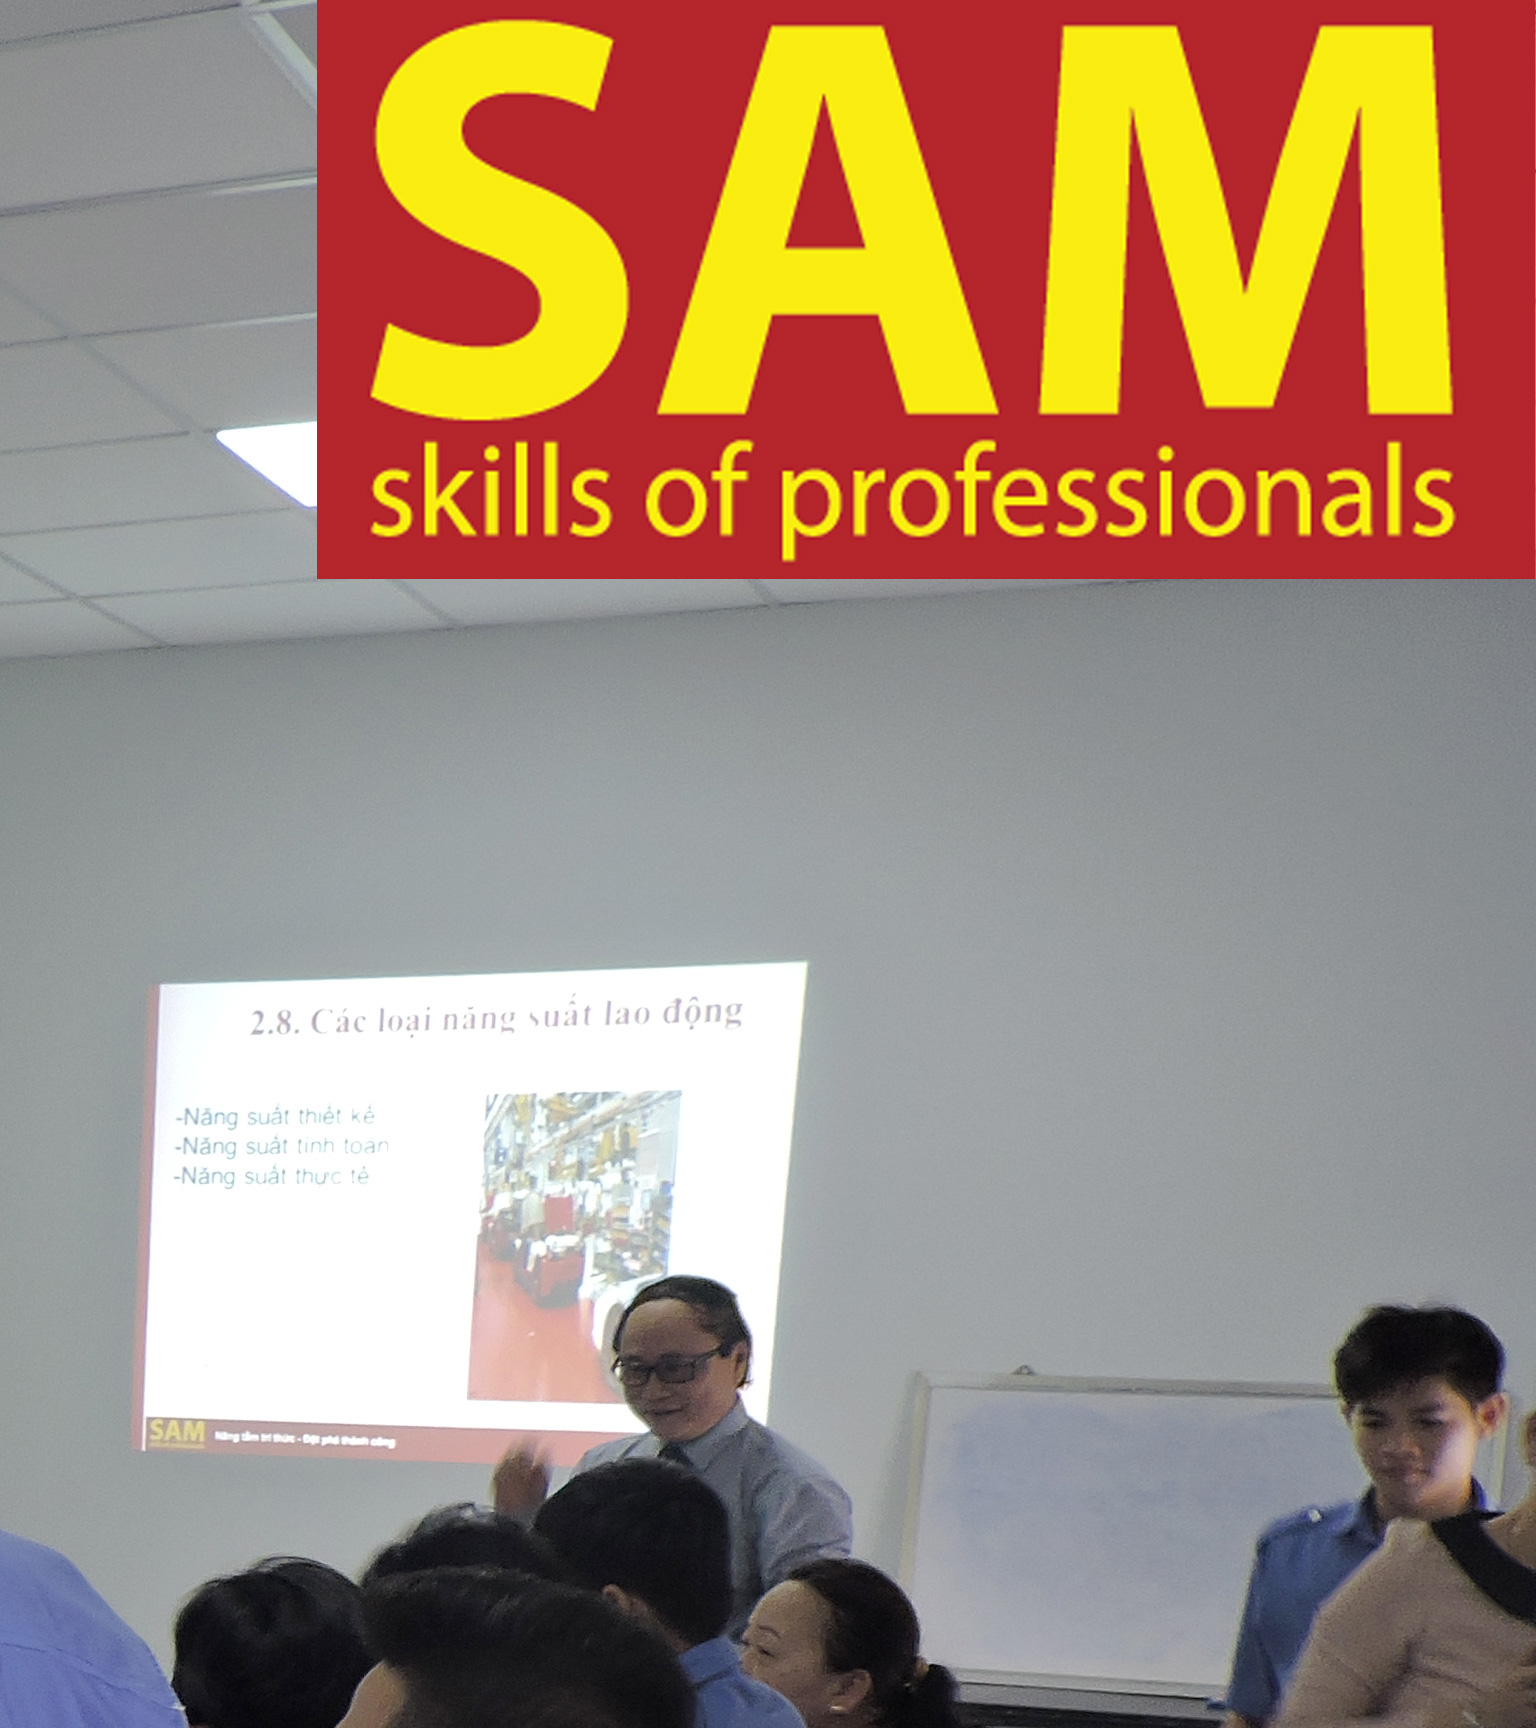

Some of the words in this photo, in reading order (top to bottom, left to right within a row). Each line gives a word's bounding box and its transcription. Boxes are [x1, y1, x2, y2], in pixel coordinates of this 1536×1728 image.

[250, 1009, 300, 1036] 2.8.
[310, 1007, 367, 1035] Các
[378, 1006, 431, 1039] loại
[443, 1005, 516, 1035] năng
[528, 992, 592, 1028] suất
[604, 999, 651, 1026] lao
[662, 995, 745, 1031] động
[149, 1418, 207, 1443] SAM
